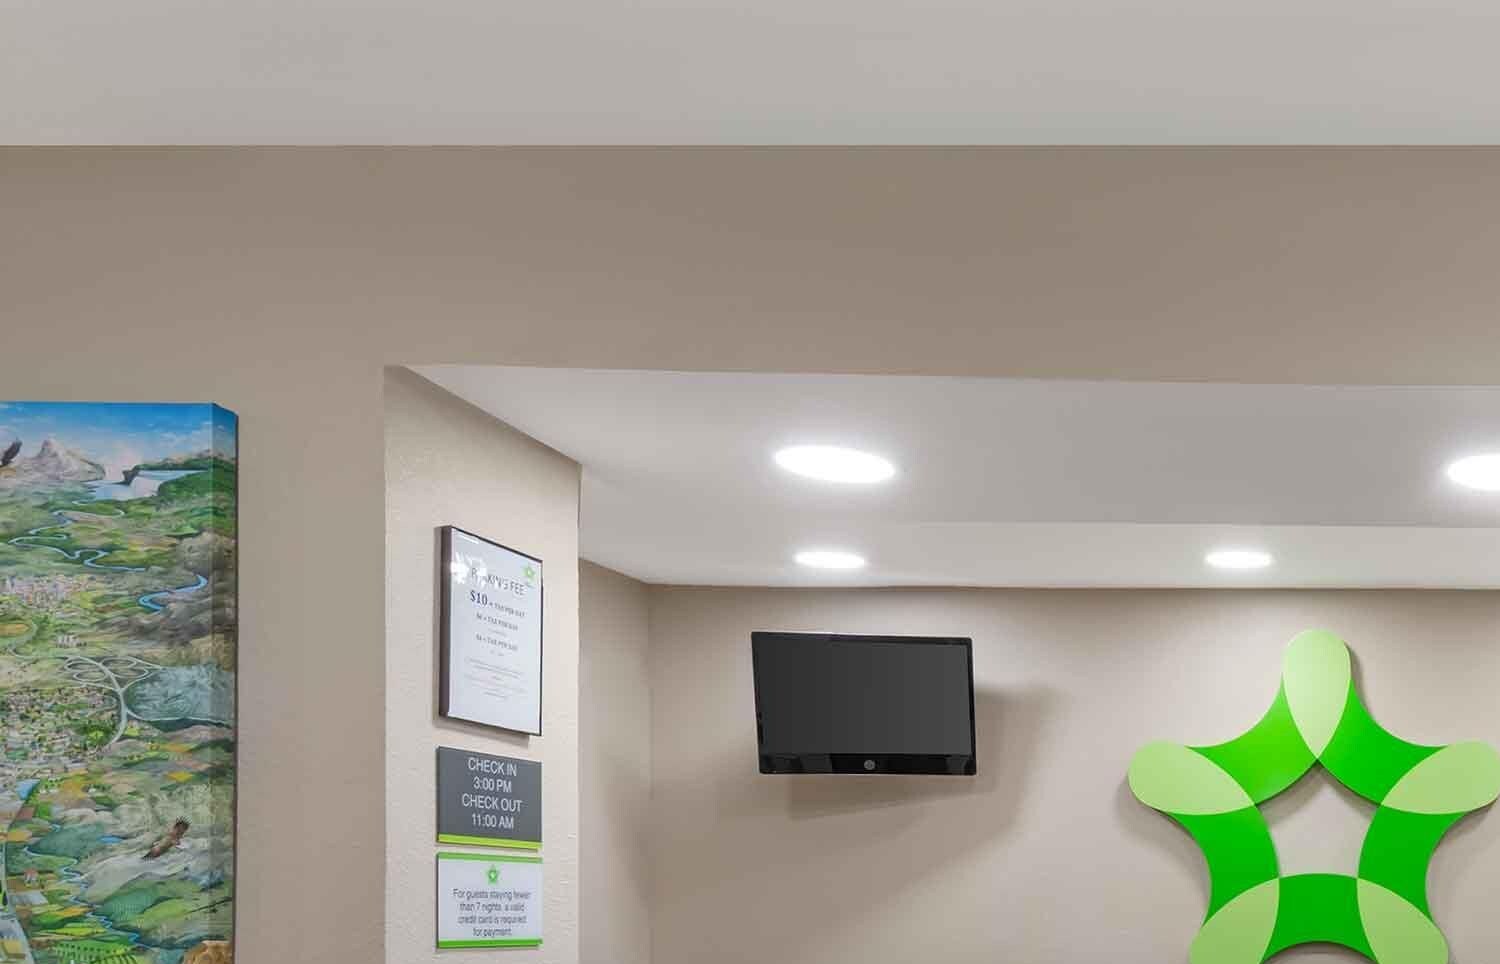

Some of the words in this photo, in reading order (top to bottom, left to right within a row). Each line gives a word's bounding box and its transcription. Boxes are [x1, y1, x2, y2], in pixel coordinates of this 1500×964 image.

[471, 568, 508, 589] PKING
[470, 590, 488, 607] $10
[468, 757, 505, 775] CHECK
[507, 763, 518, 776] IN
[473, 776, 495, 791] 3:00
[496, 779, 512, 793] PM
[462, 793, 498, 809] CHECK
[501, 797, 522, 812] OUT
[472, 814, 497, 828] 11:00
[498, 816, 514, 830] AM
[453, 888, 465, 898] For
[475, 902, 480, 910] 7
[472, 928, 482, 936] for
